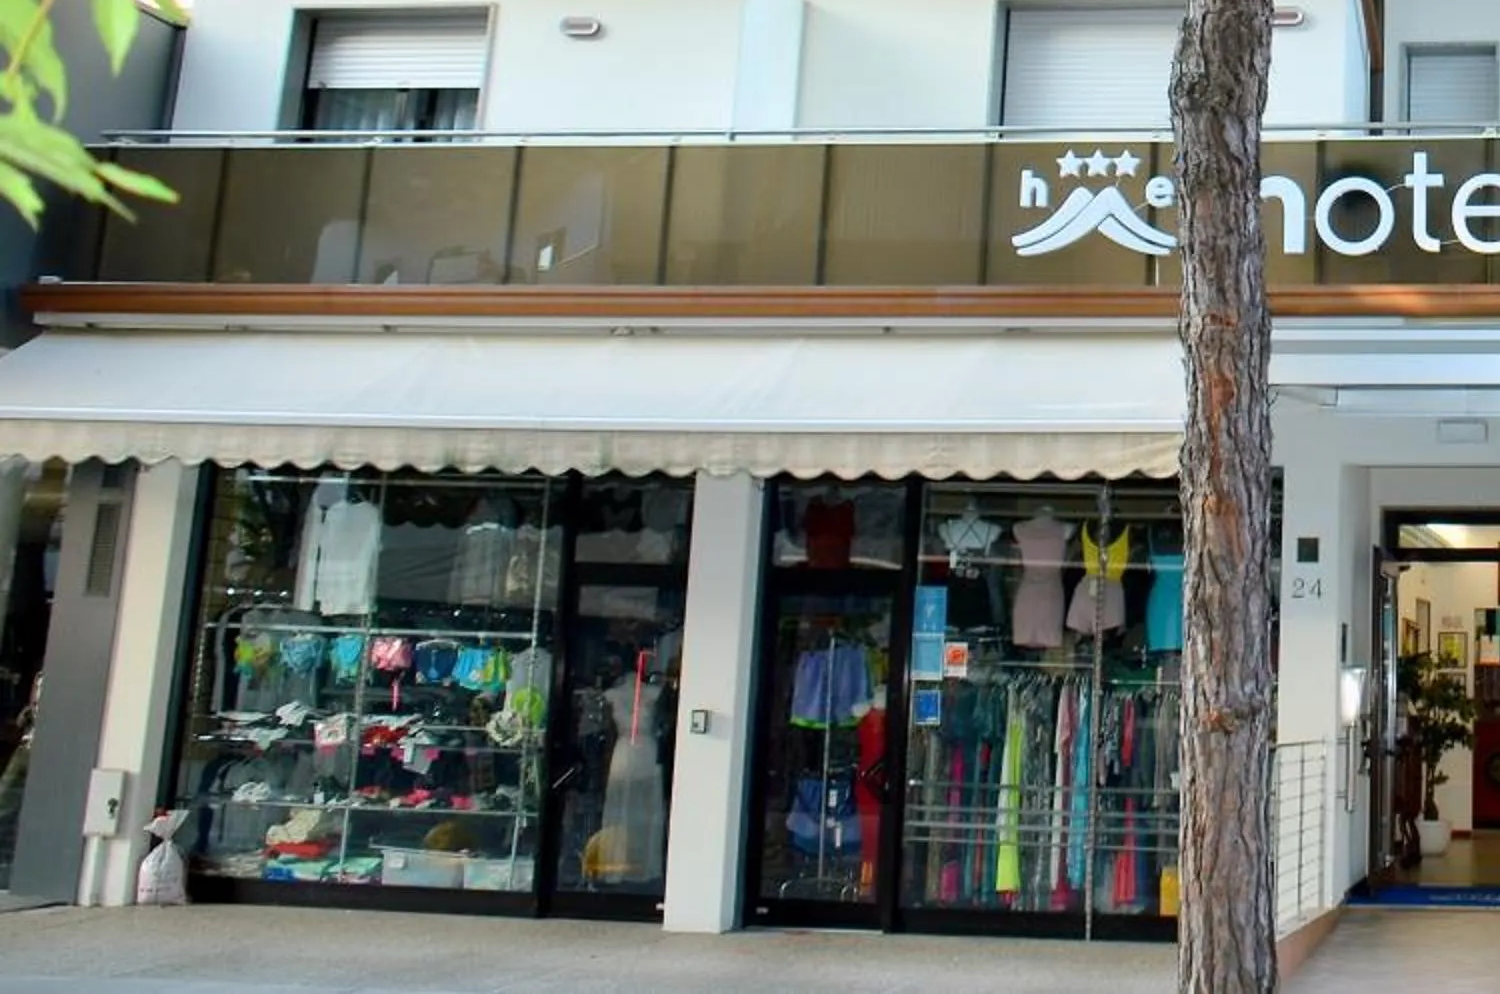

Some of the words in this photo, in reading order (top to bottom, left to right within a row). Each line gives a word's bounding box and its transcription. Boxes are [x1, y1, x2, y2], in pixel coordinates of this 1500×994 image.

[1020, 170, 1048, 206] h
[1145, 176, 1174, 206] e
[1292, 577, 1321, 599] 24
